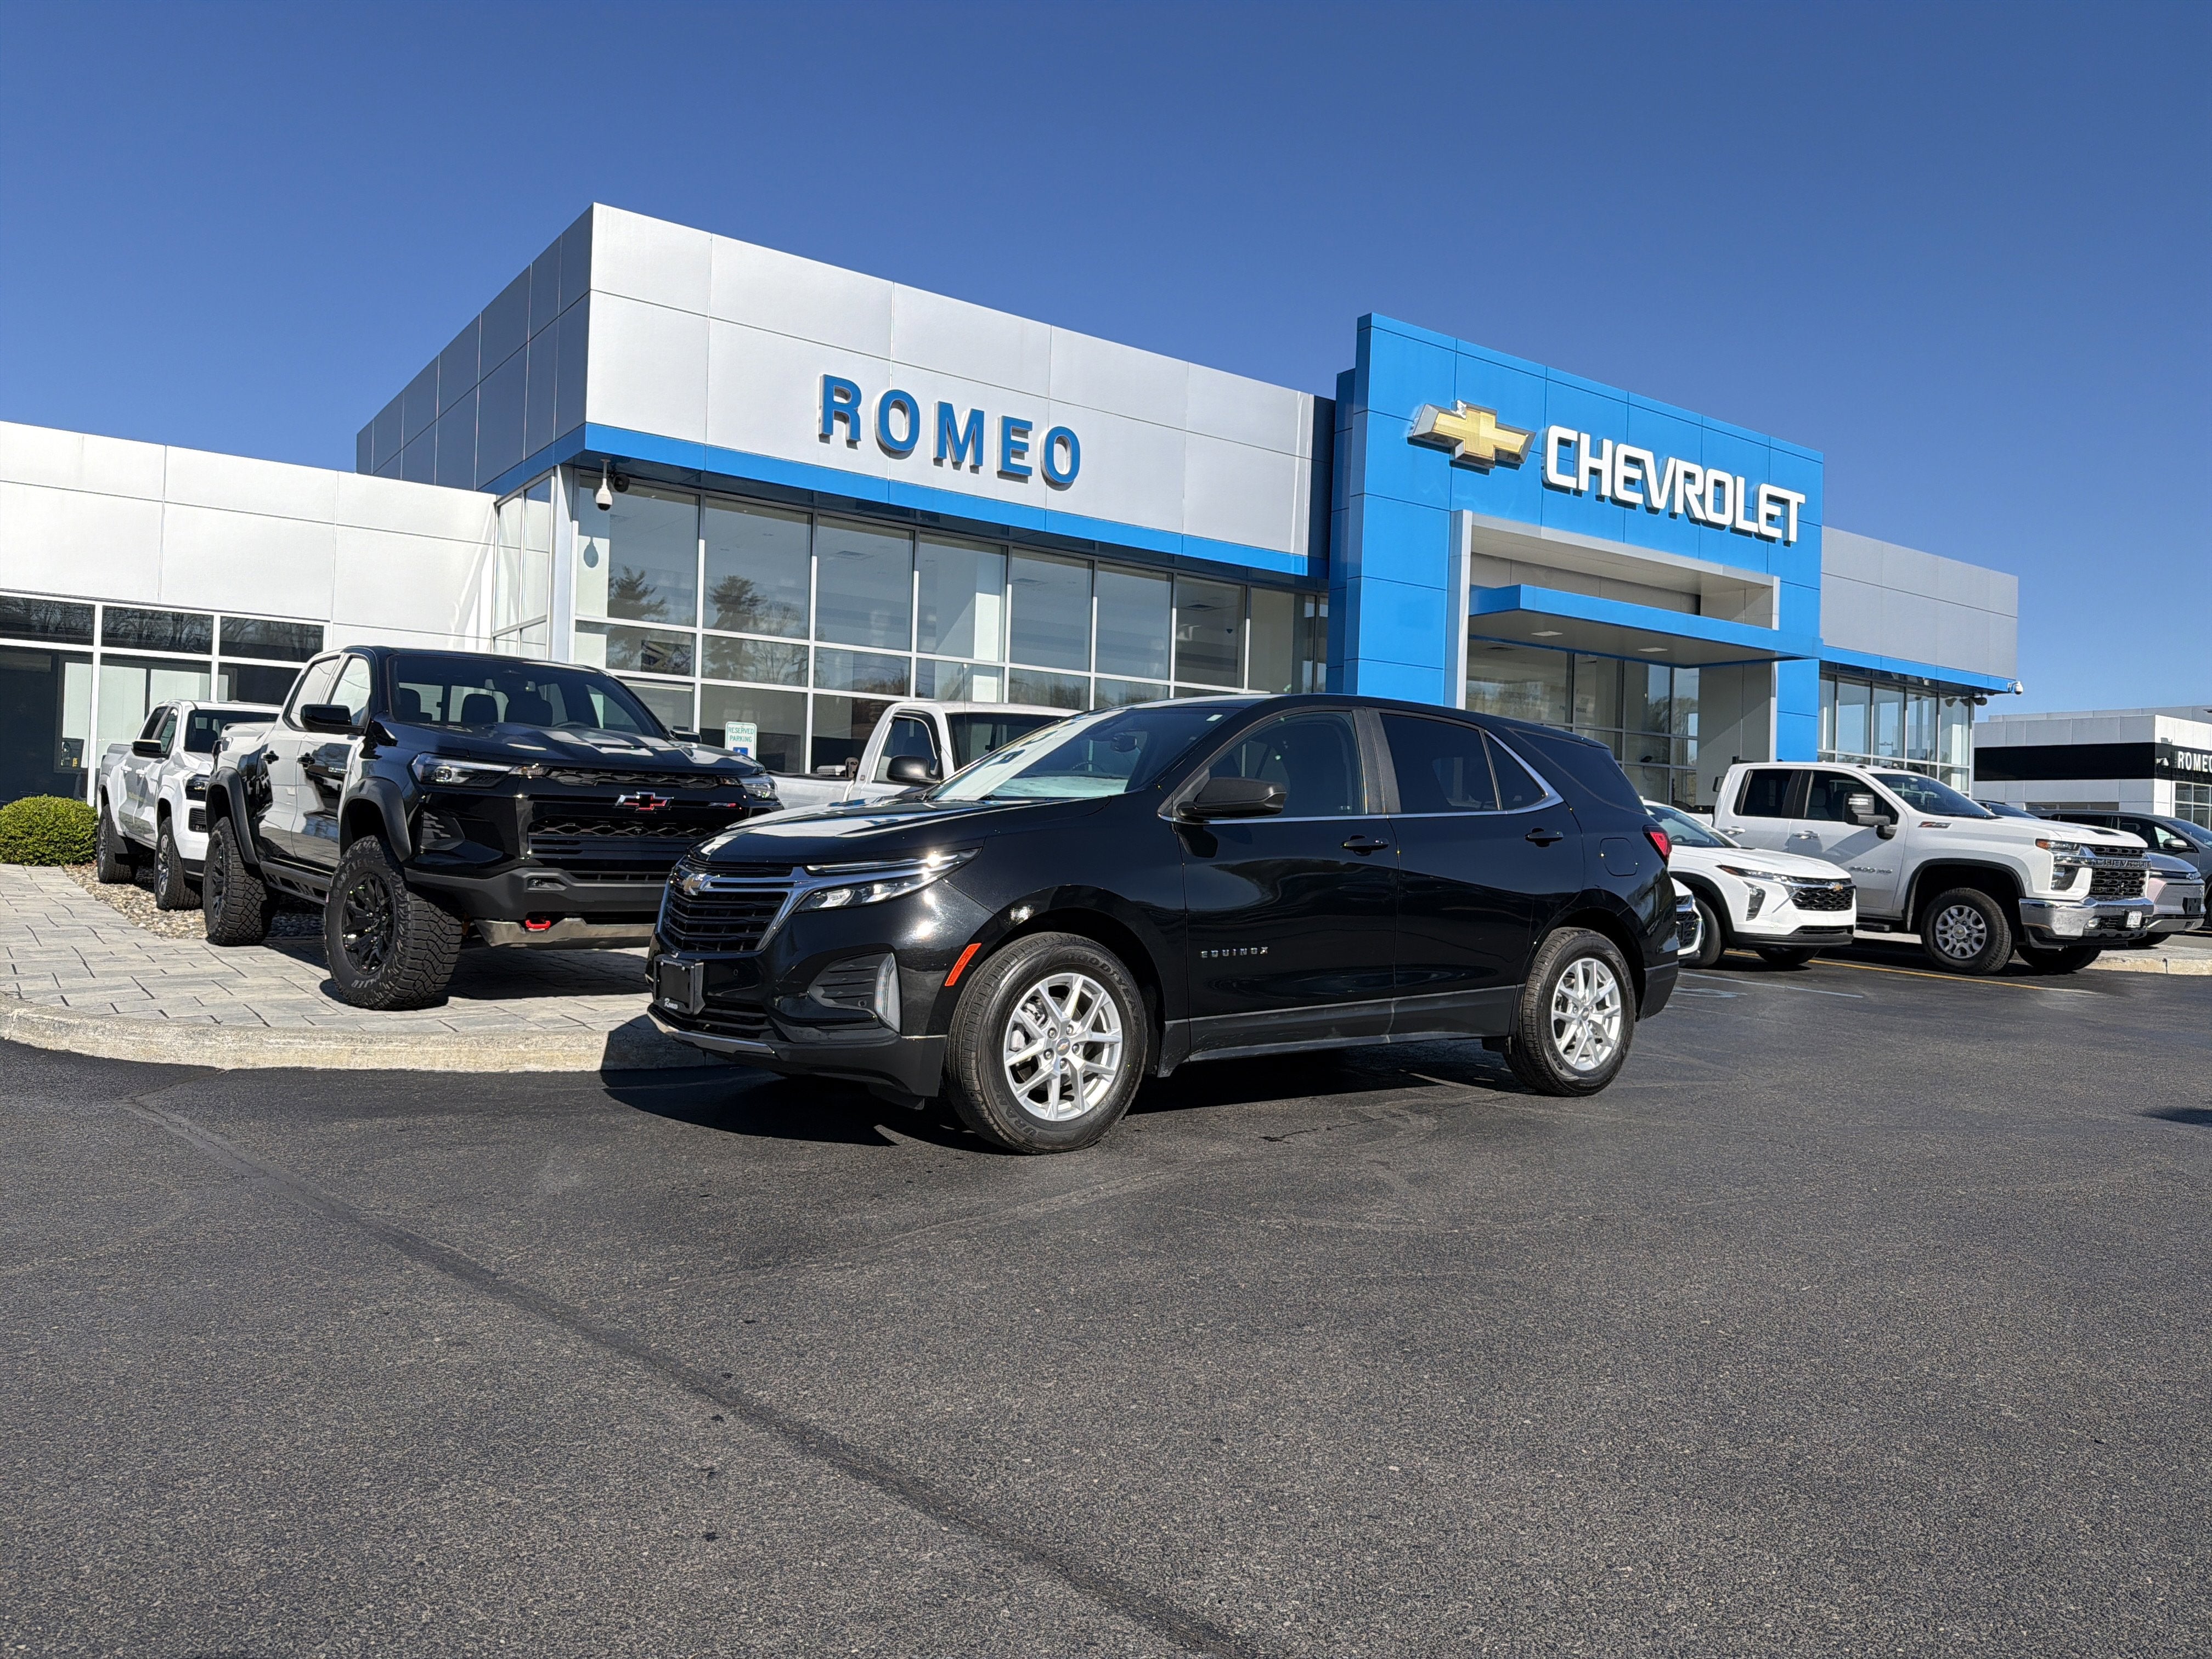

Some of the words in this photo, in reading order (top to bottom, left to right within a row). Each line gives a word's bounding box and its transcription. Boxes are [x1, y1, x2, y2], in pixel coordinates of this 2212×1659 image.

[819, 374, 1081, 484] ROMEO
[1543, 425, 1805, 543] CHEVROLET
[1069, 953, 1141, 1027] OODYEAR
[1201, 946, 1268, 958] EQUINOX
